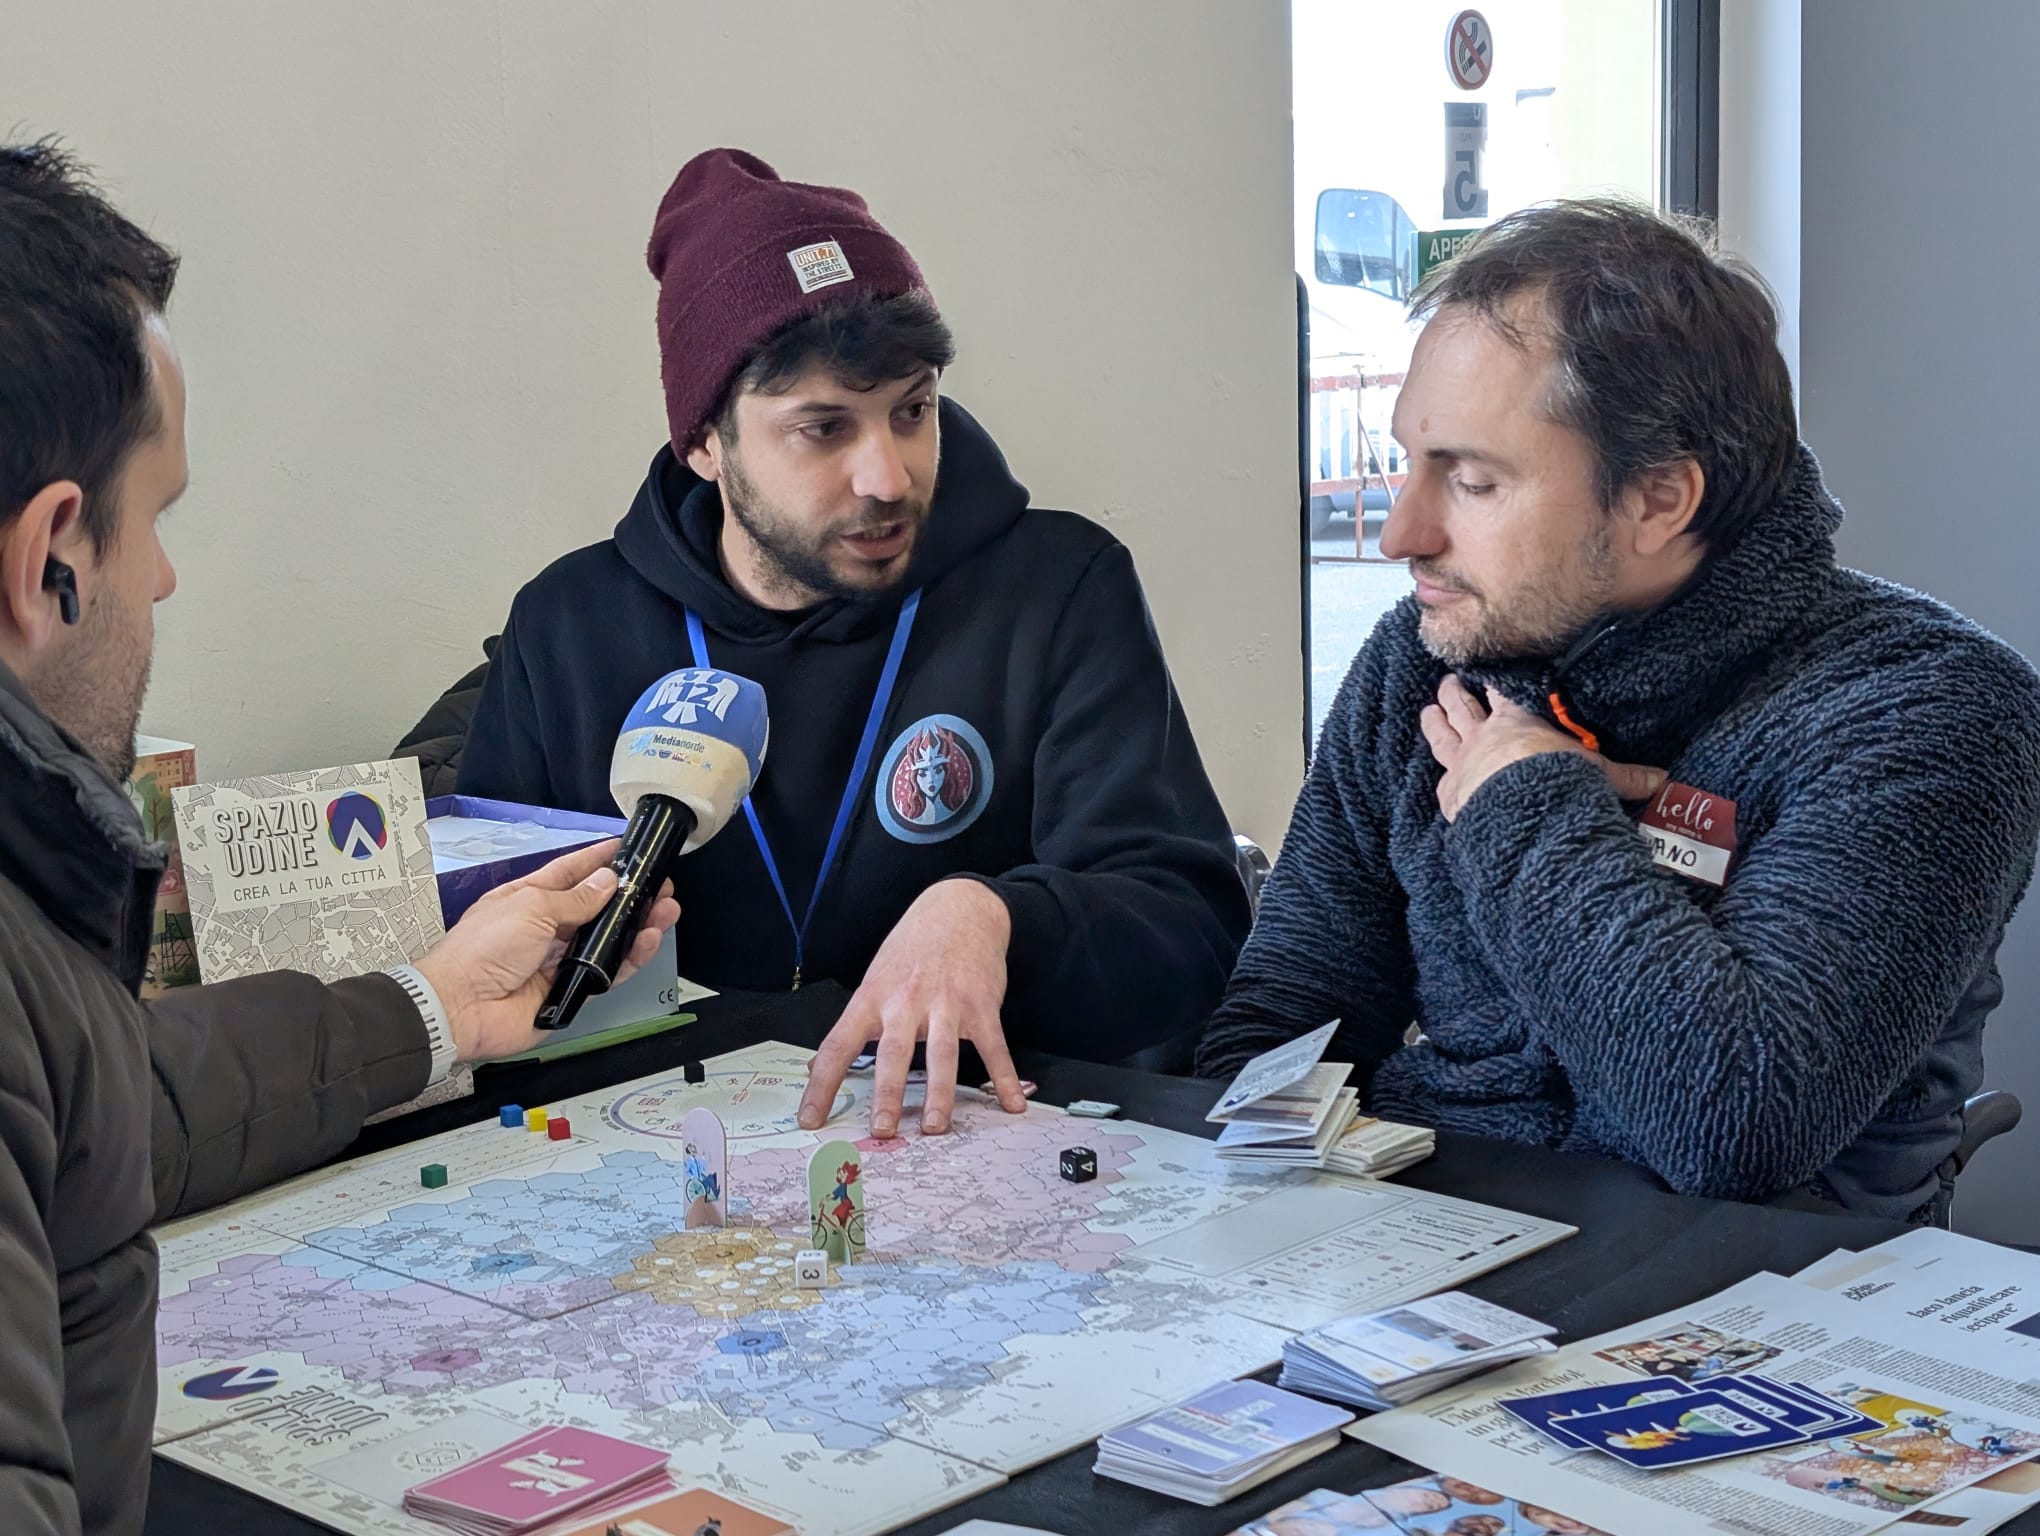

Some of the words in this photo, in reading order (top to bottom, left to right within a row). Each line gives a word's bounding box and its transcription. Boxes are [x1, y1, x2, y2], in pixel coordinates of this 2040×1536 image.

[676, 682, 718, 704] 12
[653, 734, 705, 753] Medianorde
[1656, 782, 1715, 831] hello
[212, 797, 318, 844] SPAZIO
[223, 831, 319, 878] UDINE
[233, 884, 271, 902] CREA
[279, 881, 298, 896] LA
[305, 875, 334, 891] TUA
[341, 864, 387, 886] CITTÀ
[658, 988, 674, 1005] CE
[1061, 1161, 1074, 1175] 2
[1080, 1160, 1095, 1173] 4
[802, 1269, 820, 1280] 3
[1935, 1284, 1984, 1305] lancia
[1939, 1285, 2022, 1325] riqualificare
